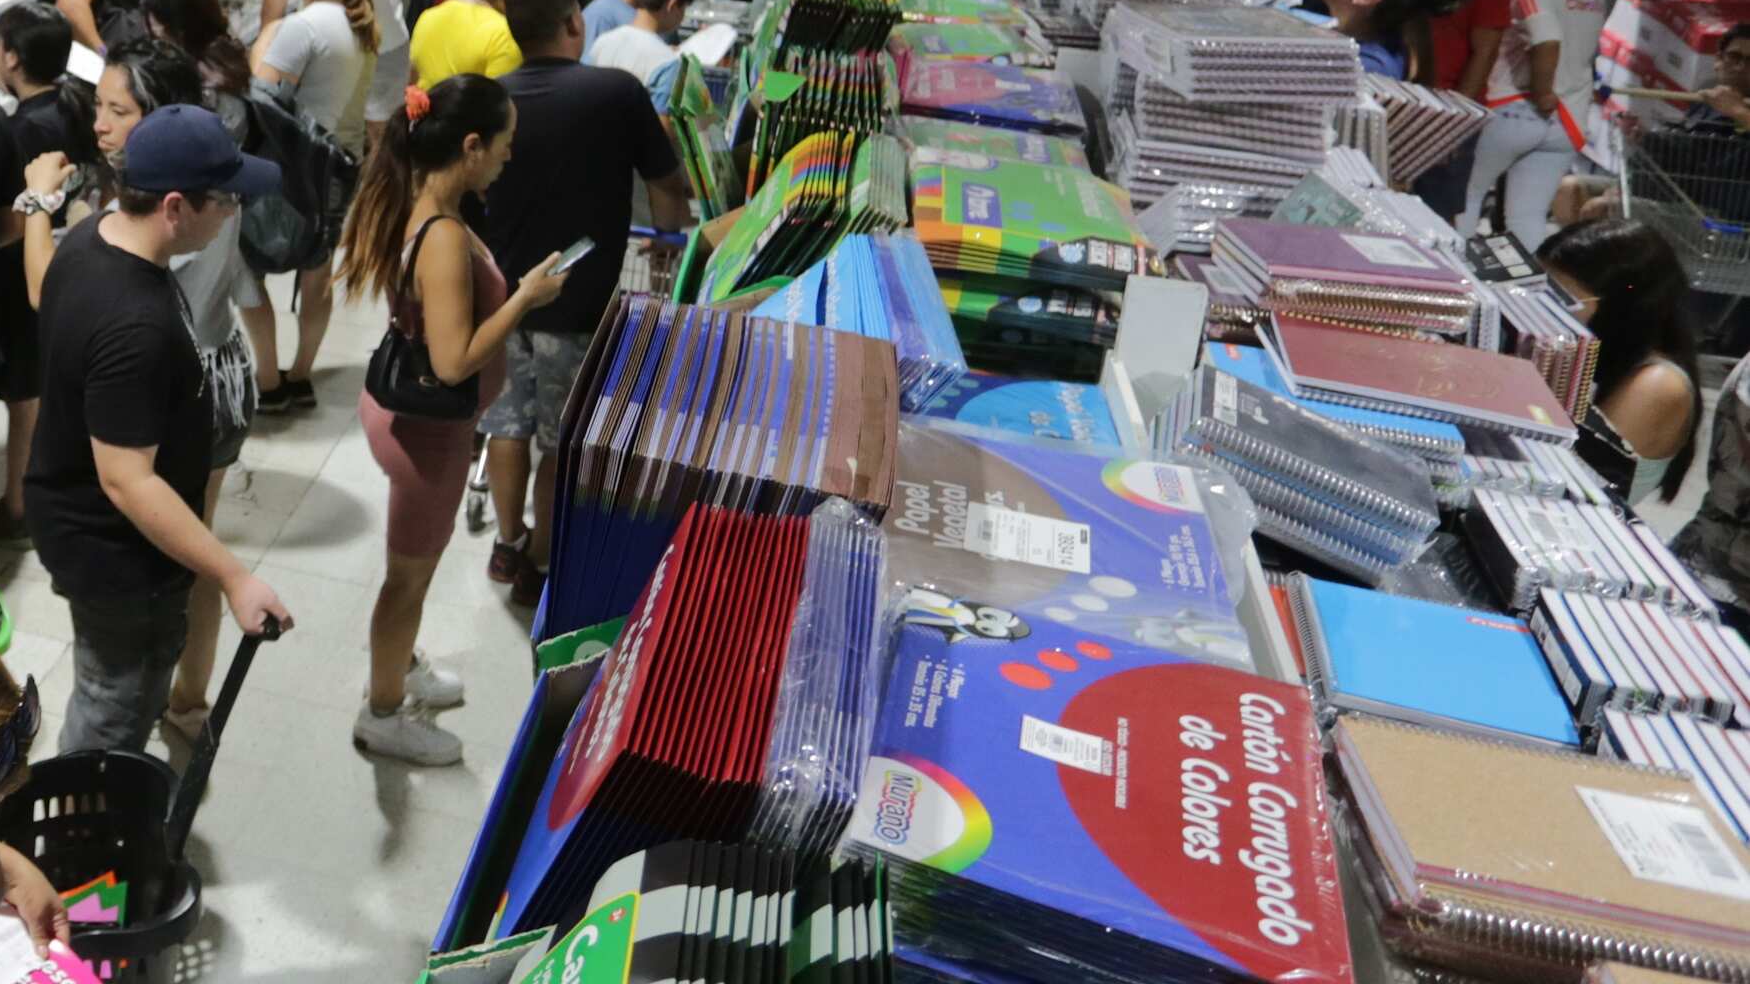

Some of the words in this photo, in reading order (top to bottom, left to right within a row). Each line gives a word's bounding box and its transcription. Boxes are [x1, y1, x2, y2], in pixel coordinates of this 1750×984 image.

[894, 479, 940, 535] Papel
[1178, 715, 1227, 751] de
[1239, 693, 1292, 775] Cartón
[876, 771, 918, 843] Murano
[1180, 758, 1232, 866] Colores
[1238, 782, 1314, 946] Corrugado
